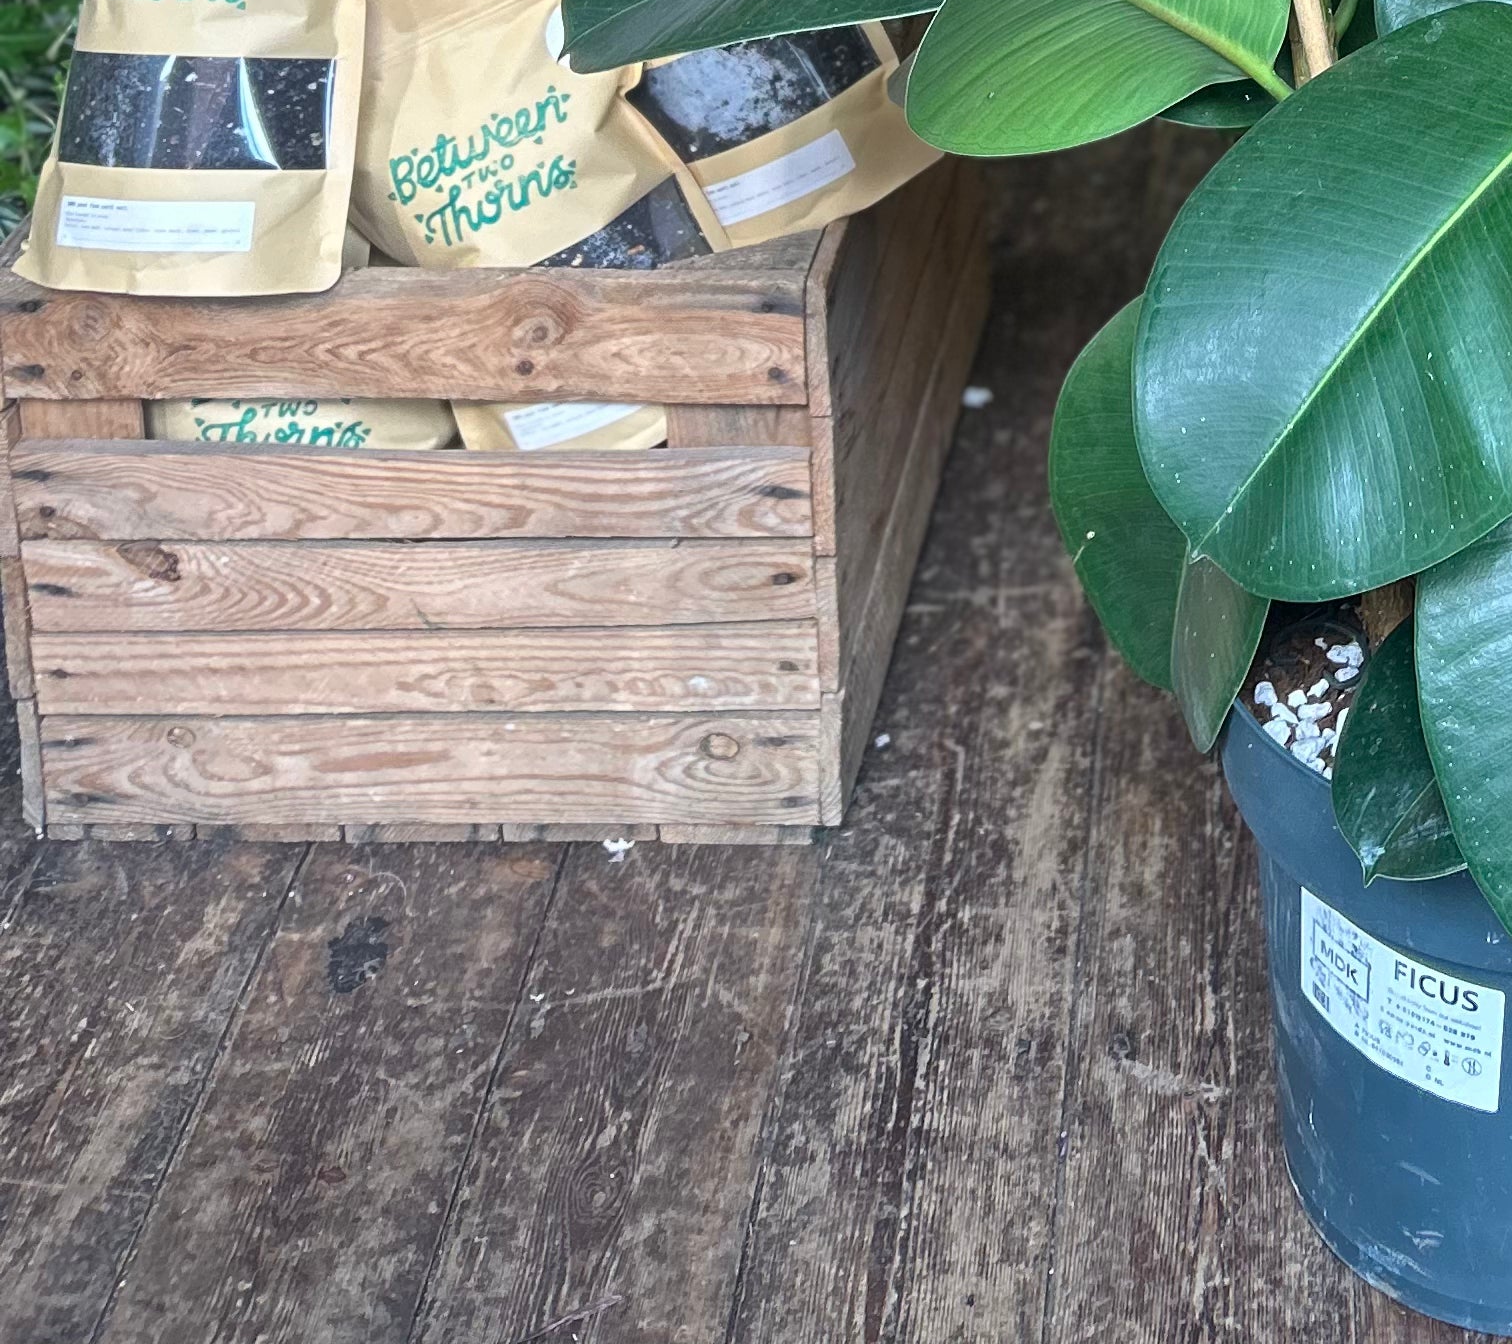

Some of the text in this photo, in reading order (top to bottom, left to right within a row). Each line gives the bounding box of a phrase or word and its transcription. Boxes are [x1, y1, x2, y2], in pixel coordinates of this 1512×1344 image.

[389, 95, 568, 205] Between
[461, 153, 514, 189] TWO
[425, 154, 575, 246] Thorns
[261, 399, 318, 418] TWO
[1320, 939, 1358, 986] MDK
[1394, 959, 1479, 1012] FICUS
